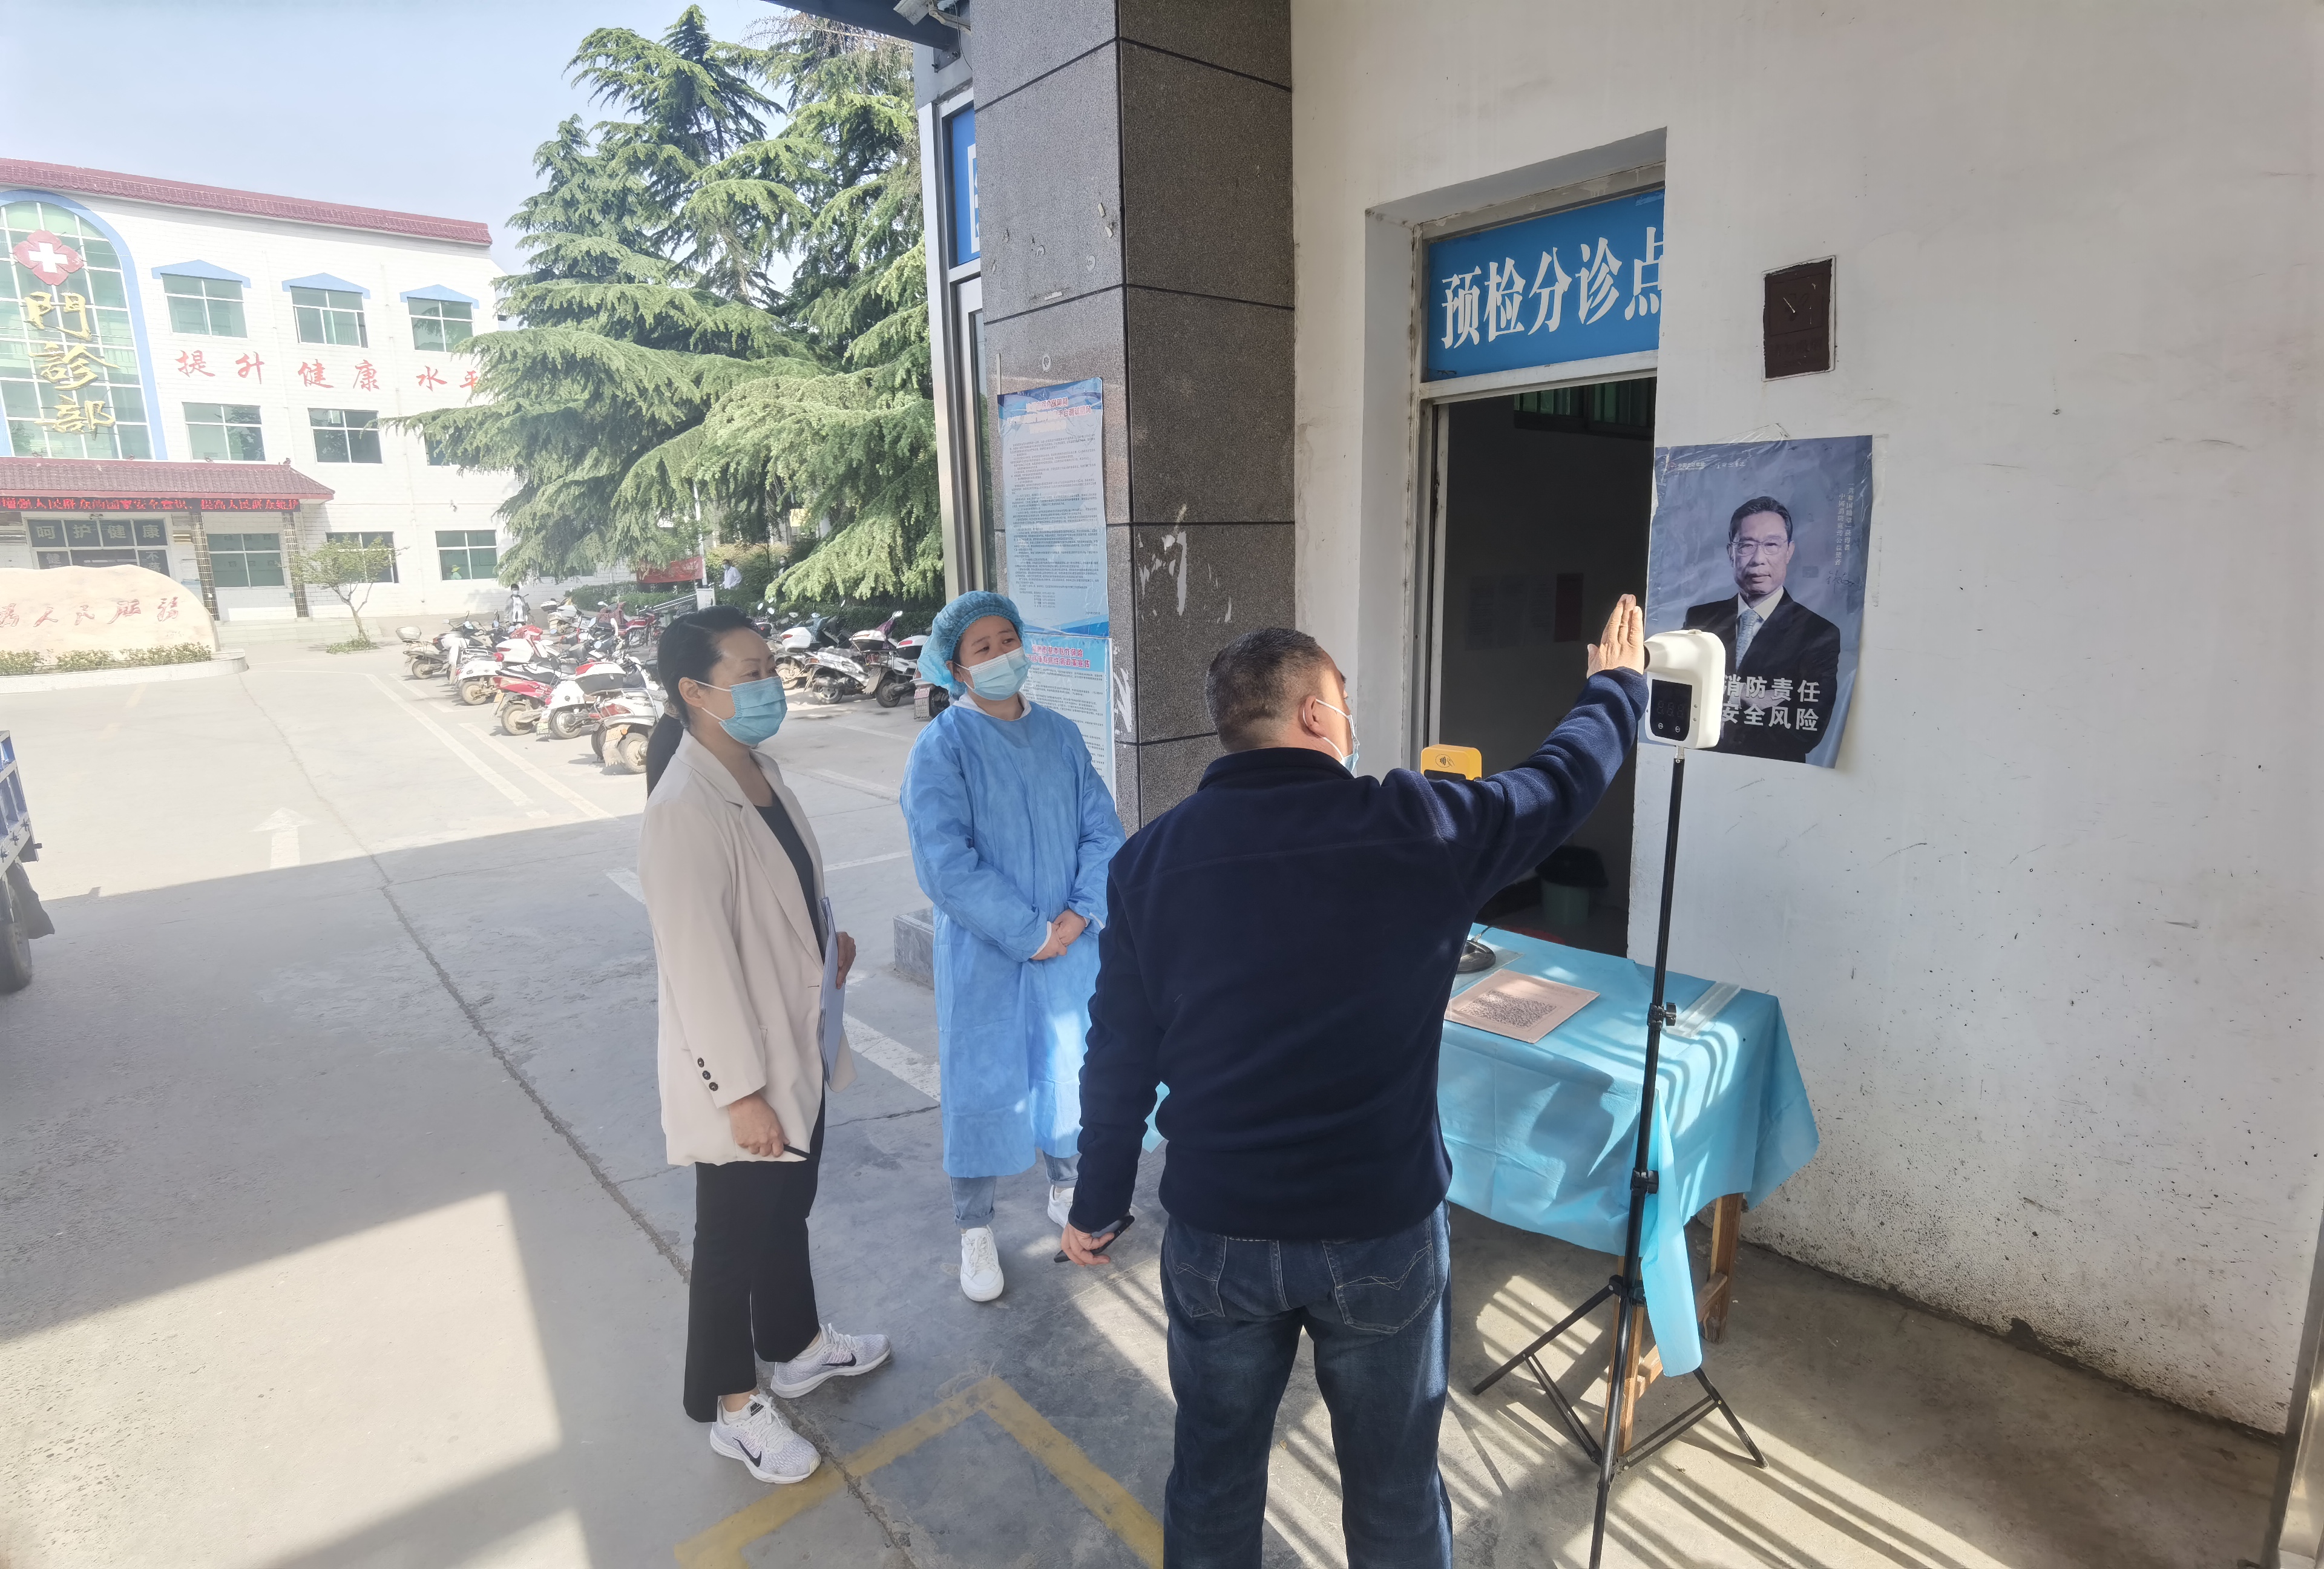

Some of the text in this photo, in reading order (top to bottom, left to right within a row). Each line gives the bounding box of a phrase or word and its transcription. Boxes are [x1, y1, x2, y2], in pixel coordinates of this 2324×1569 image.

[1441, 226, 1663, 349] 预检分诊点
[1724, 674, 1820, 703] 消防责任
[1722, 700, 1819, 731] 安全风险
